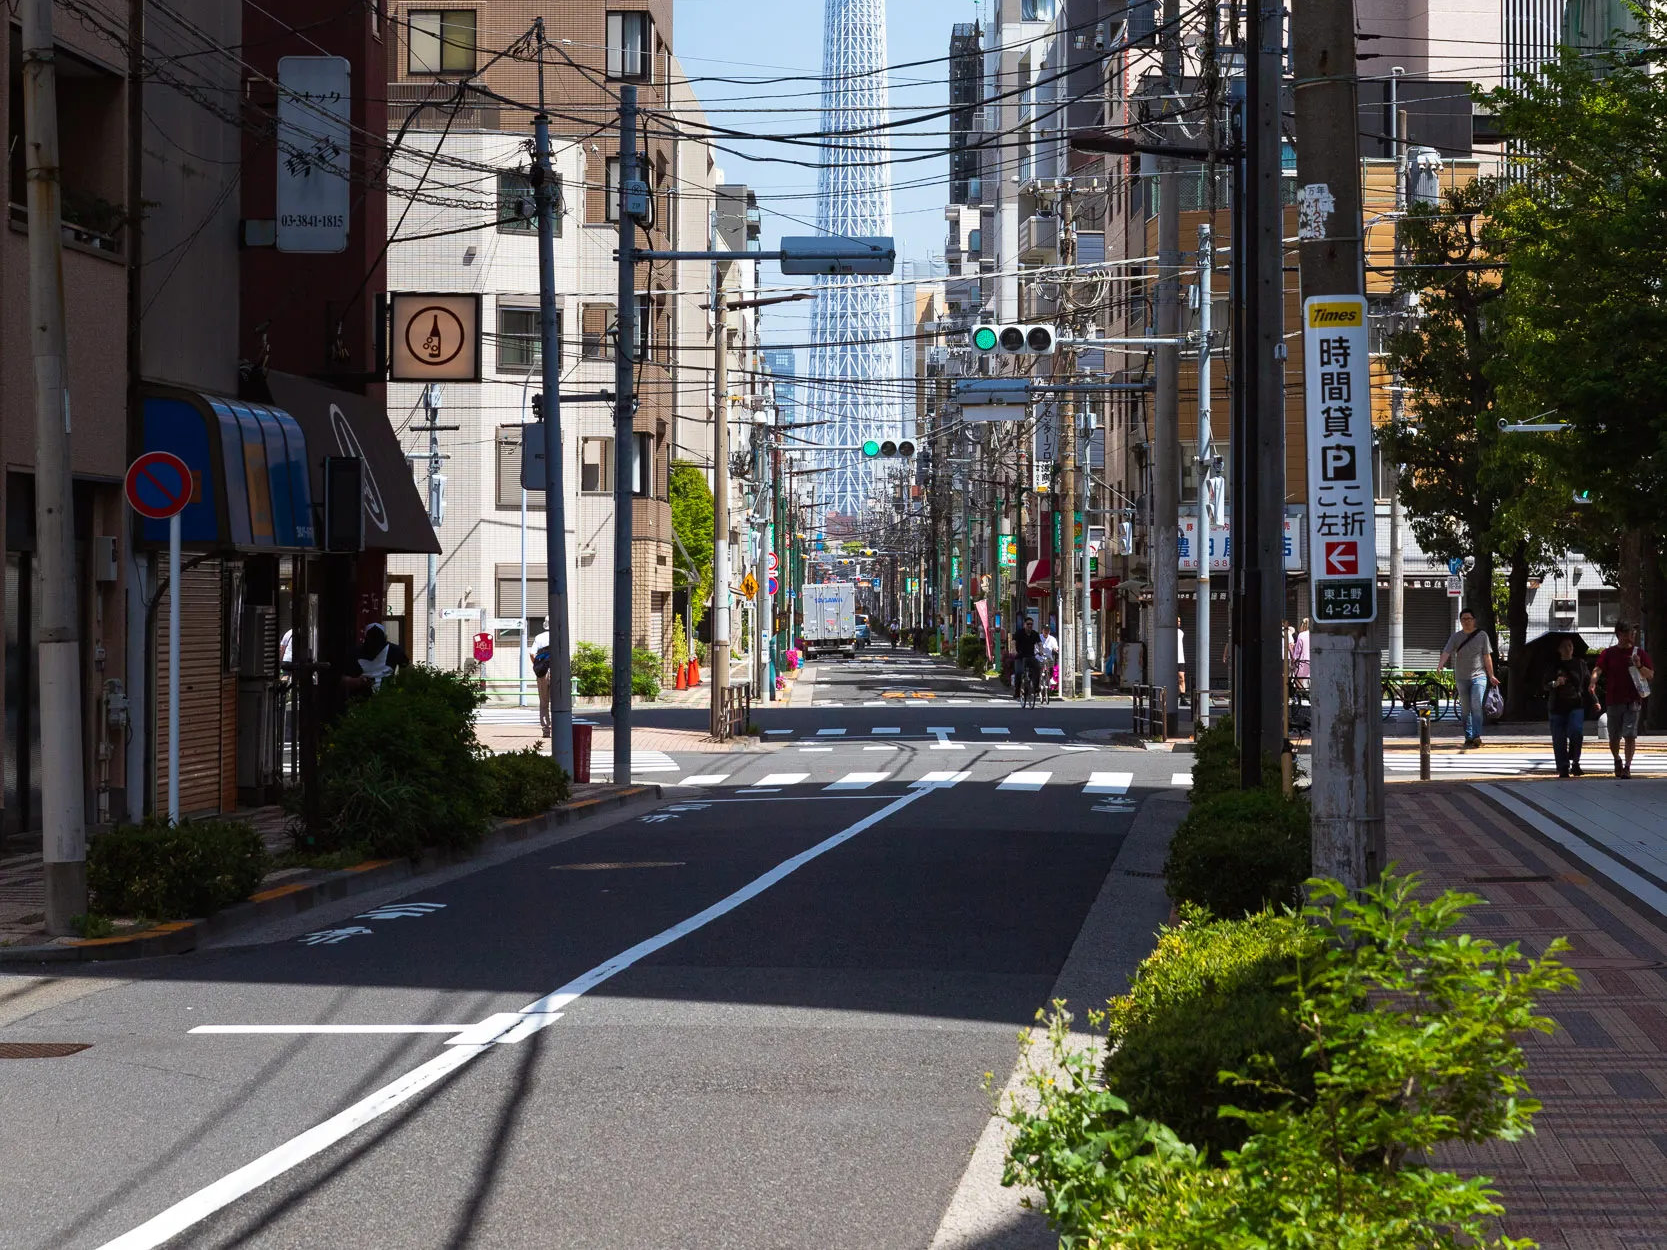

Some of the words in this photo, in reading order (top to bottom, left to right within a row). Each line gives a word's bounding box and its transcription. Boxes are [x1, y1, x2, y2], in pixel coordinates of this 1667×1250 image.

[281, 214, 344, 228] 03-3841-1815
[1313, 309, 1357, 322] Times
[1320, 336, 1352, 438] 時間貸
[1317, 485, 1364, 507] ここ
[1317, 511, 1366, 537] 左折
[1323, 588, 1363, 601] 東上野
[1325, 603, 1361, 616] 4-24
